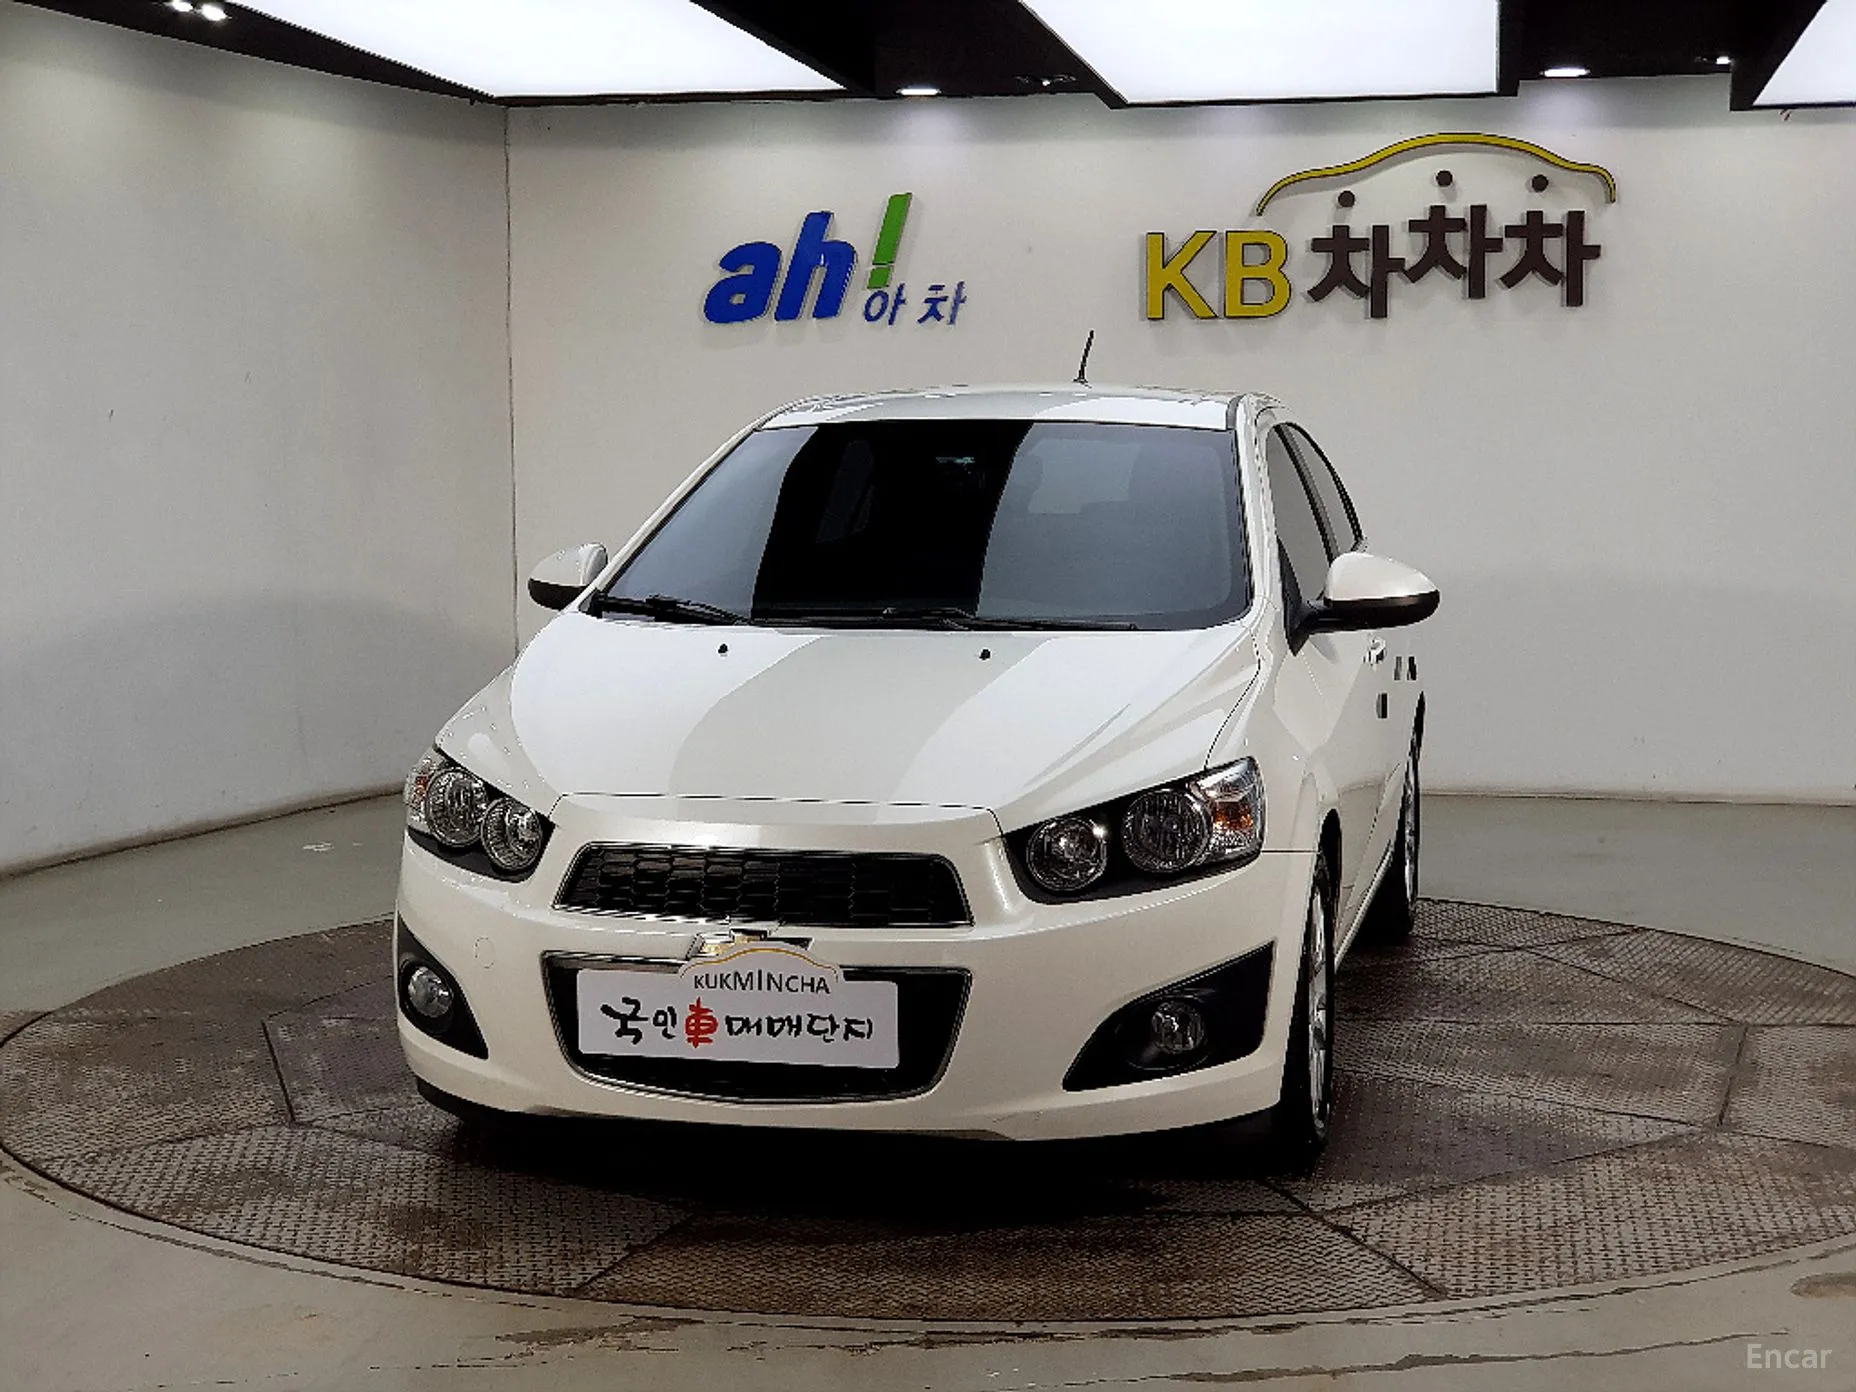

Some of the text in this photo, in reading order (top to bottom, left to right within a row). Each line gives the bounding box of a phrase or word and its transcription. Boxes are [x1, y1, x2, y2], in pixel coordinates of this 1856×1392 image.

[703, 192, 912, 324] ah!
[1145, 169, 1601, 320] KB 차차차
[693, 969, 831, 995] KUKMINCHA
